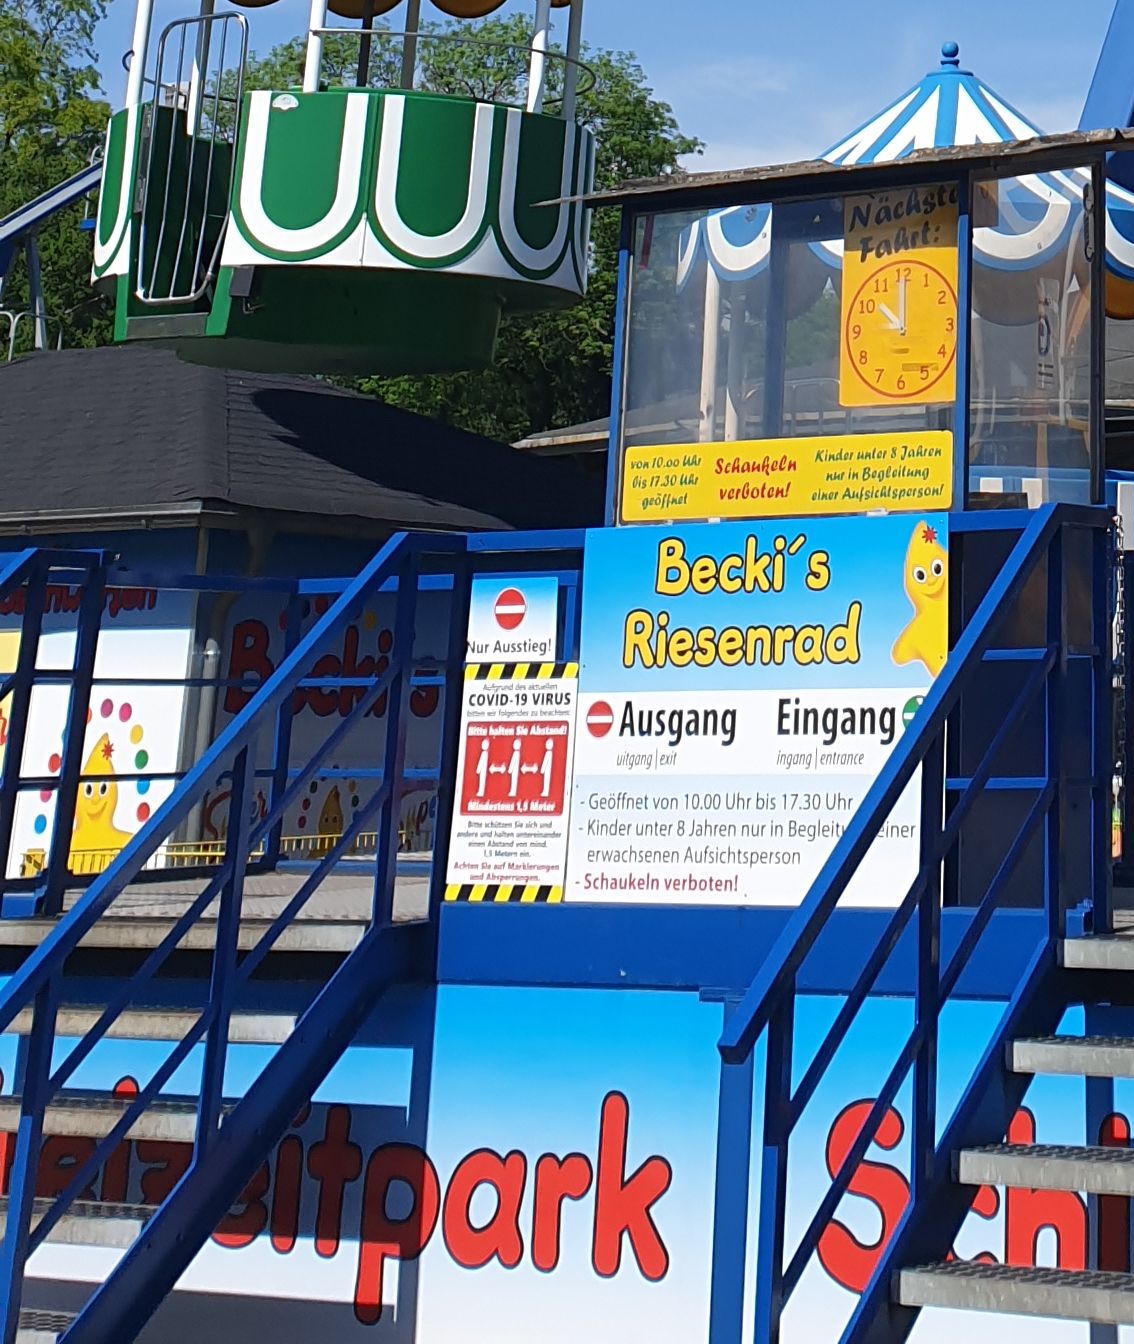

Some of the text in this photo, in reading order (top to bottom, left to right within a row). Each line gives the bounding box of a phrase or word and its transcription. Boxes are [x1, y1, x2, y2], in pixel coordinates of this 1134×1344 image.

[859, 224, 940, 263] Fahrt:
[895, 268, 911, 282] 12
[923, 273, 929, 288] 1
[874, 278, 889, 293] 11
[938, 291, 947, 305] 2
[859, 299, 876, 313] 10
[852, 325, 862, 339] 9
[945, 318, 954, 333] 3
[859, 351, 868, 365] 8
[937, 343, 947, 358] 4
[874, 369, 885, 383] 7
[920, 366, 930, 380] 5
[896, 375, 906, 390] 6
[815, 445, 942, 463] Kinder unter 8 Jahren
[630, 461, 650, 470] von
[682, 455, 702, 467] Uhr
[714, 455, 797, 478] Schaukeln
[632, 474, 699, 489] bis 17.30 Uhr
[825, 467, 929, 482] nur in Begleitung
[719, 482, 791, 501] verboten!
[811, 484, 944, 503] einer Aufsichtsperson!
[641, 493, 688, 510] geöffnet
[622, 601, 862, 668] Riesenrad
[467, 638, 552, 656] Nur Ausstieg!
[468, 692, 571, 706] COVID-19 VIRUS
[618, 700, 737, 746] Ausgang
[777, 698, 896, 745] Eingang
[468, 724, 568, 736] Bitte halten Sie Abstand!
[467, 800, 556, 812] Mindestens 1,5 Meter
[588, 792, 853, 810] Geöffnet von 10.00 Uhr bis 17.30 Uhr
[587, 819, 916, 842] Kinder unter 8 Jahren nur in Begleit einer
[587, 846, 801, 869] erwachsenen Aufsichtsperson
[453, 862, 479, 870] Achten
[481, 862, 491, 870] Sie
[494, 862, 505, 870] auf
[470, 873, 484, 881] und
[583, 873, 738, 892] Schaukeln verboten!
